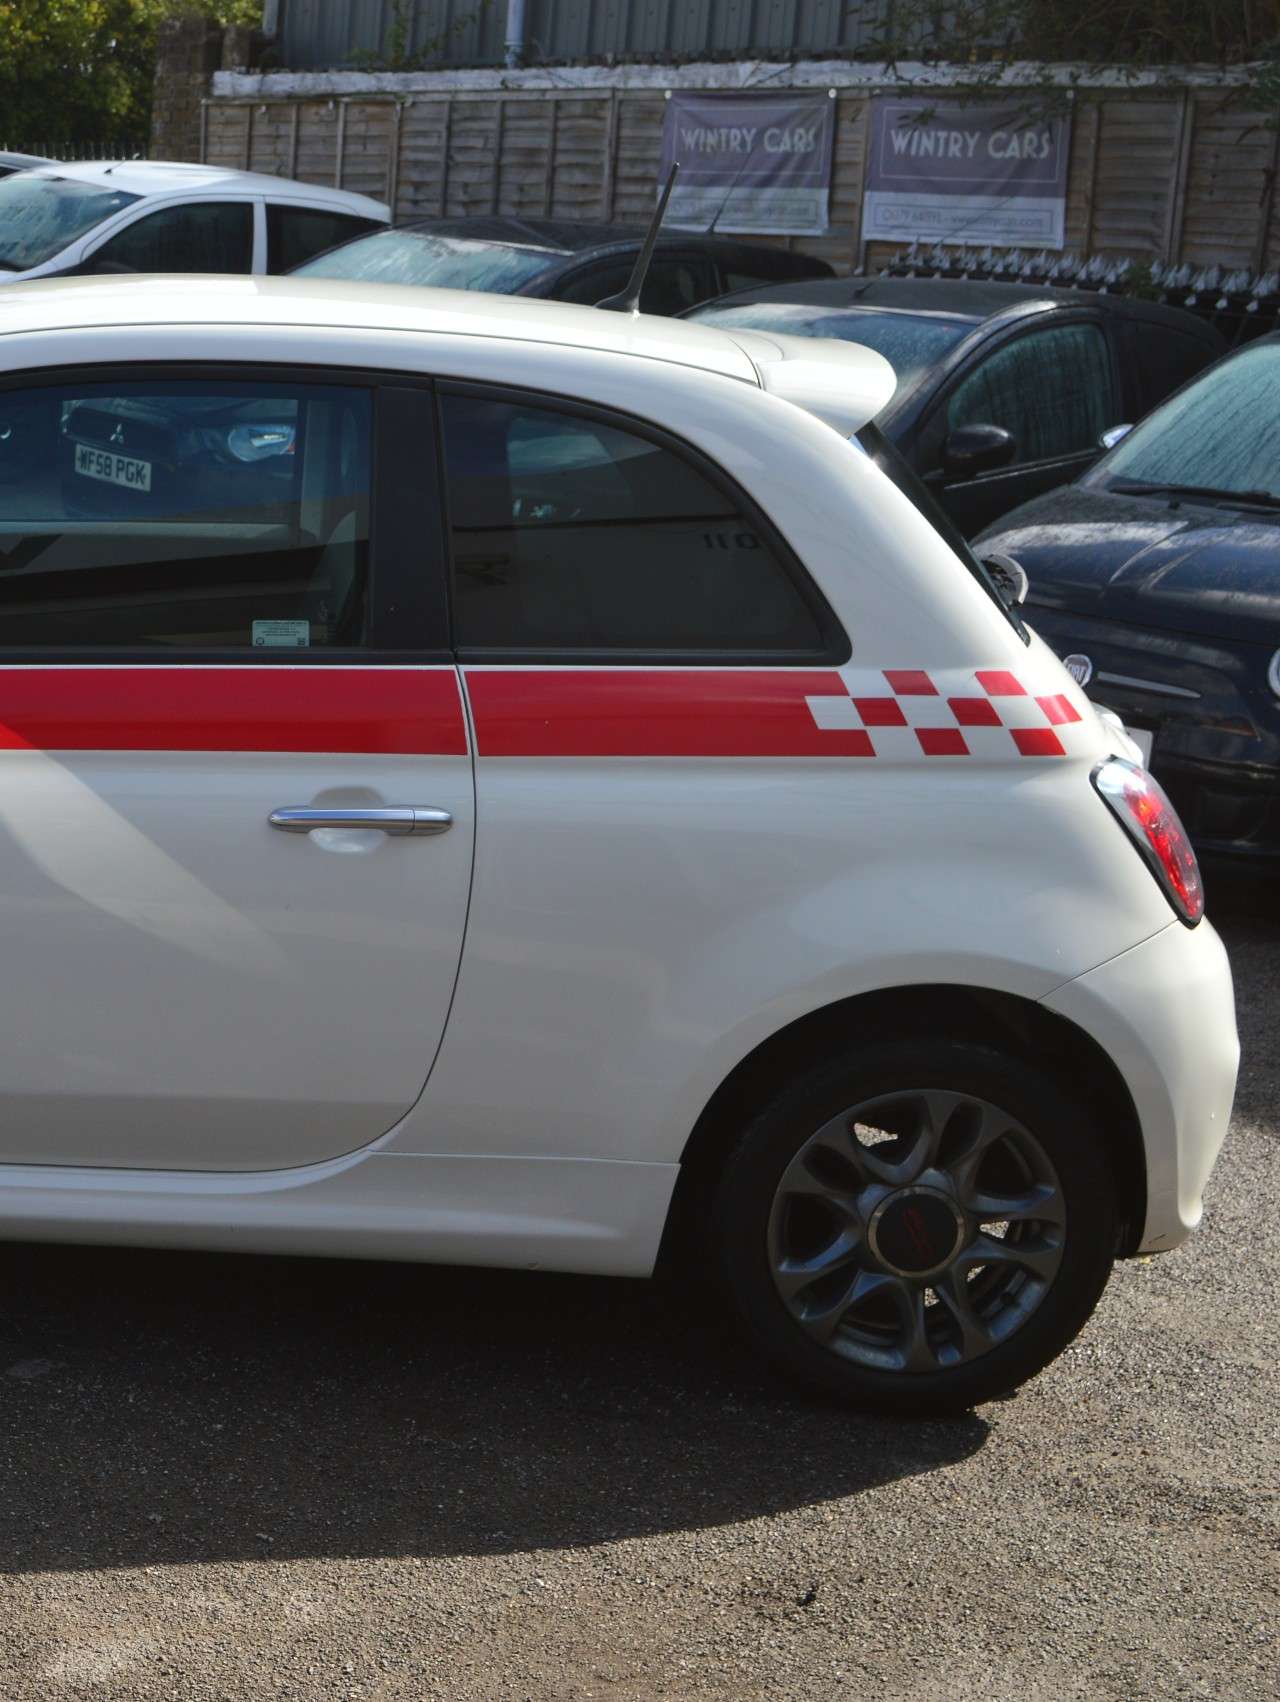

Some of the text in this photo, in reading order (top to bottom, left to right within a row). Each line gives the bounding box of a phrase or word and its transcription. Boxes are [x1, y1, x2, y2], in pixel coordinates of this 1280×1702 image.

[680, 127, 816, 154] WINTRY CARS
[890, 129, 1050, 159] WINTRY CARS
[116, 458, 145, 484] PGK
